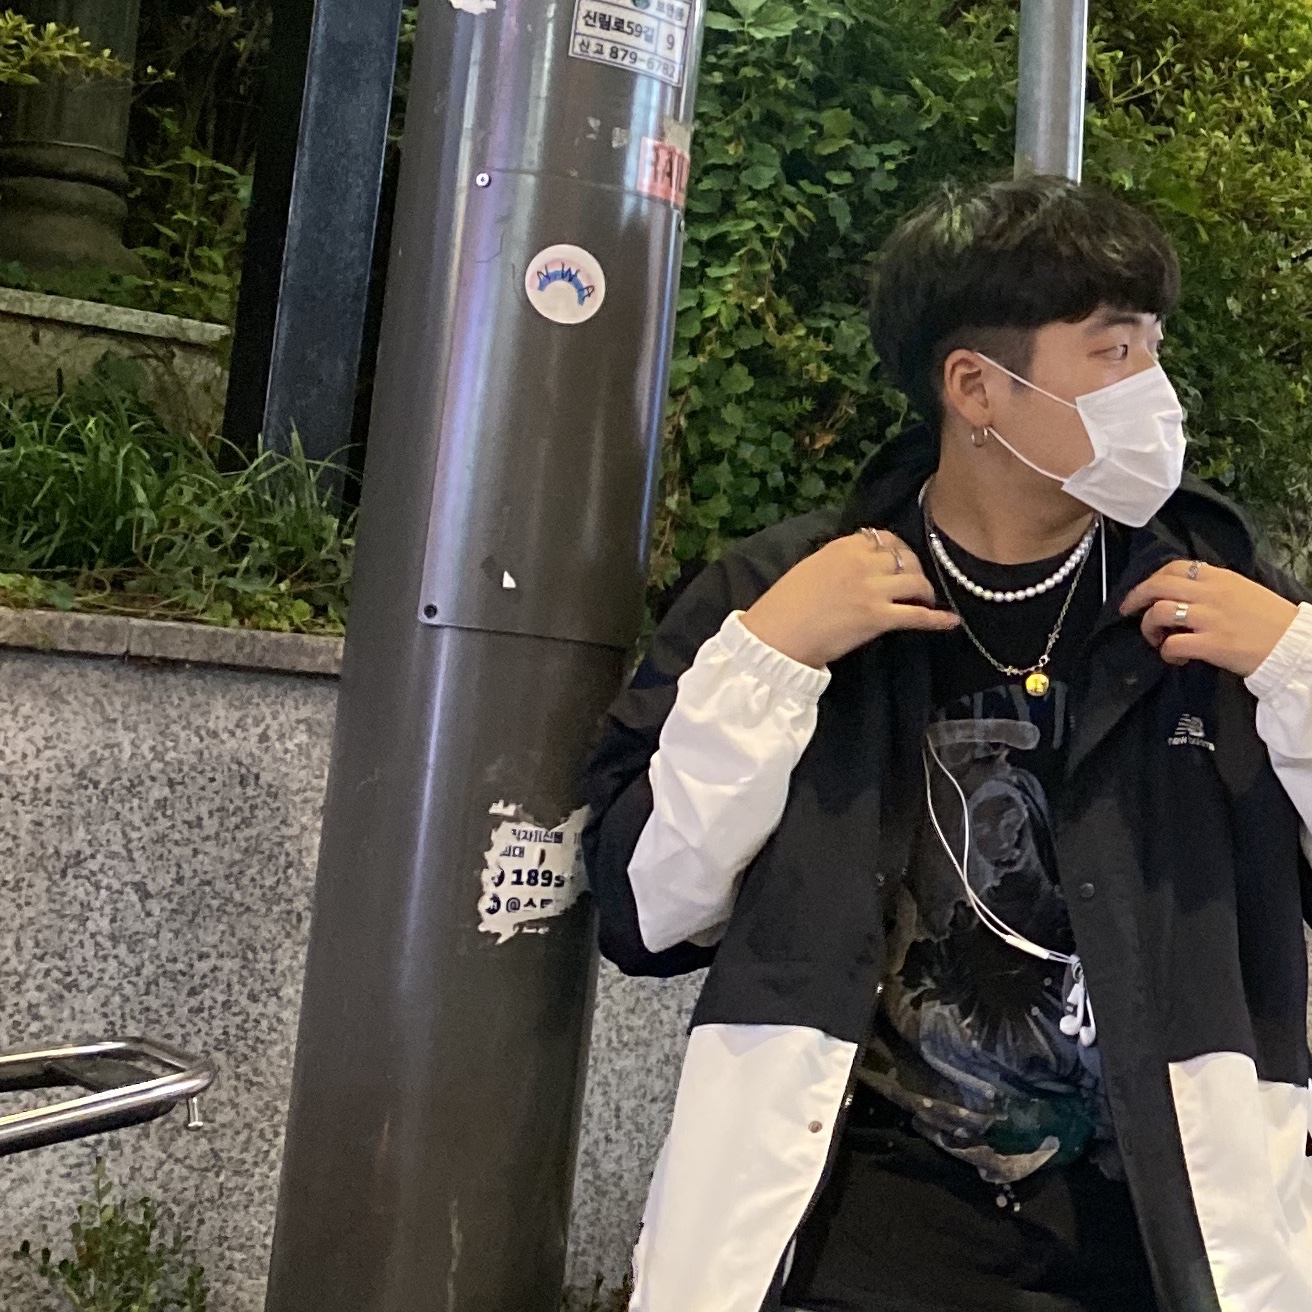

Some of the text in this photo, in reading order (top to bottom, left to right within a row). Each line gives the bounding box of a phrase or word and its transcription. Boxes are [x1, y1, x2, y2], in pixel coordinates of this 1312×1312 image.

[666, 33, 675, 51] 9
[579, 38, 676, 78] 신고 879-6782
